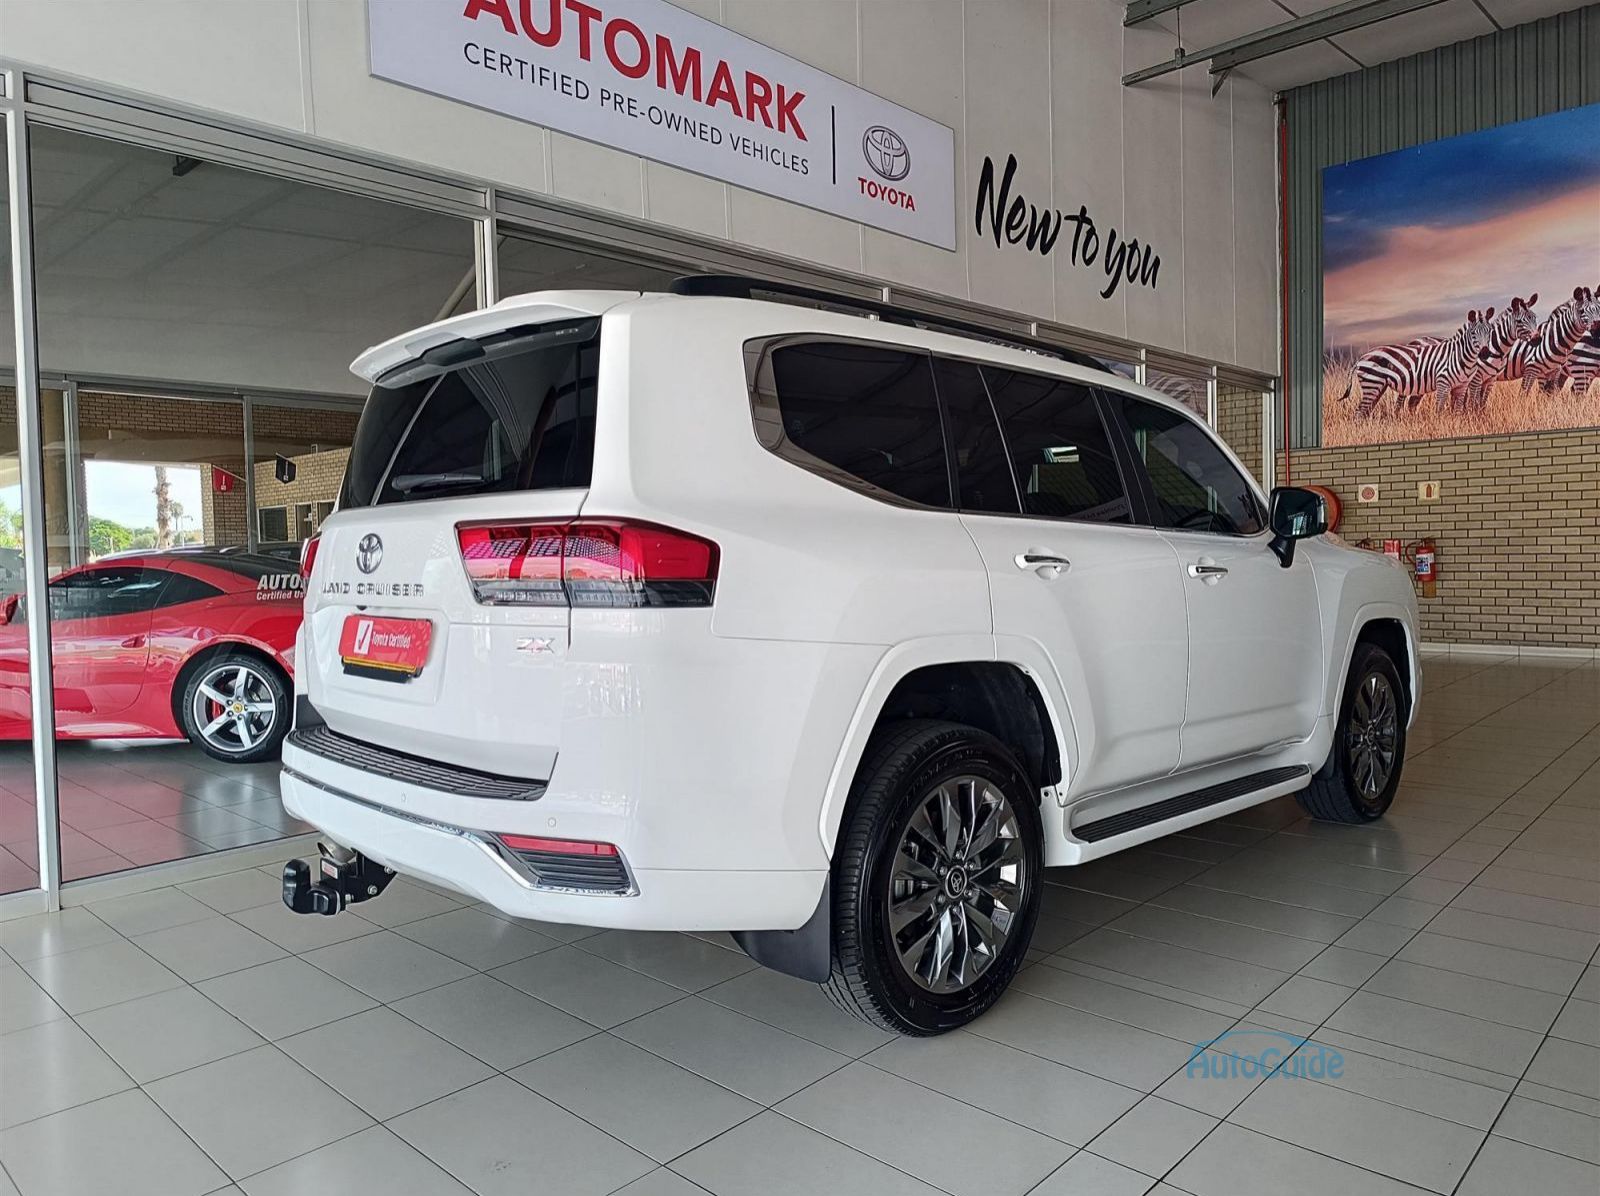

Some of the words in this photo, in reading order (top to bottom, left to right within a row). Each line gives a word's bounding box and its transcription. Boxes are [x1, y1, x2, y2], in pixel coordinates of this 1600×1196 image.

[463, 42, 590, 101] CERTIFIED
[600, 87, 723, 146] PRE-OWNED
[729, 132, 810, 176] VEHICLES
[857, 176, 916, 212] TOYOTA
[975, 153, 1062, 256] New
[1063, 204, 1100, 267] to
[1099, 227, 1161, 299] you
[256, 590, 292, 601] Certified
[294, 589, 305, 599] Us
[322, 581, 351, 594] LAND
[356, 582, 425, 597] CRUISER
